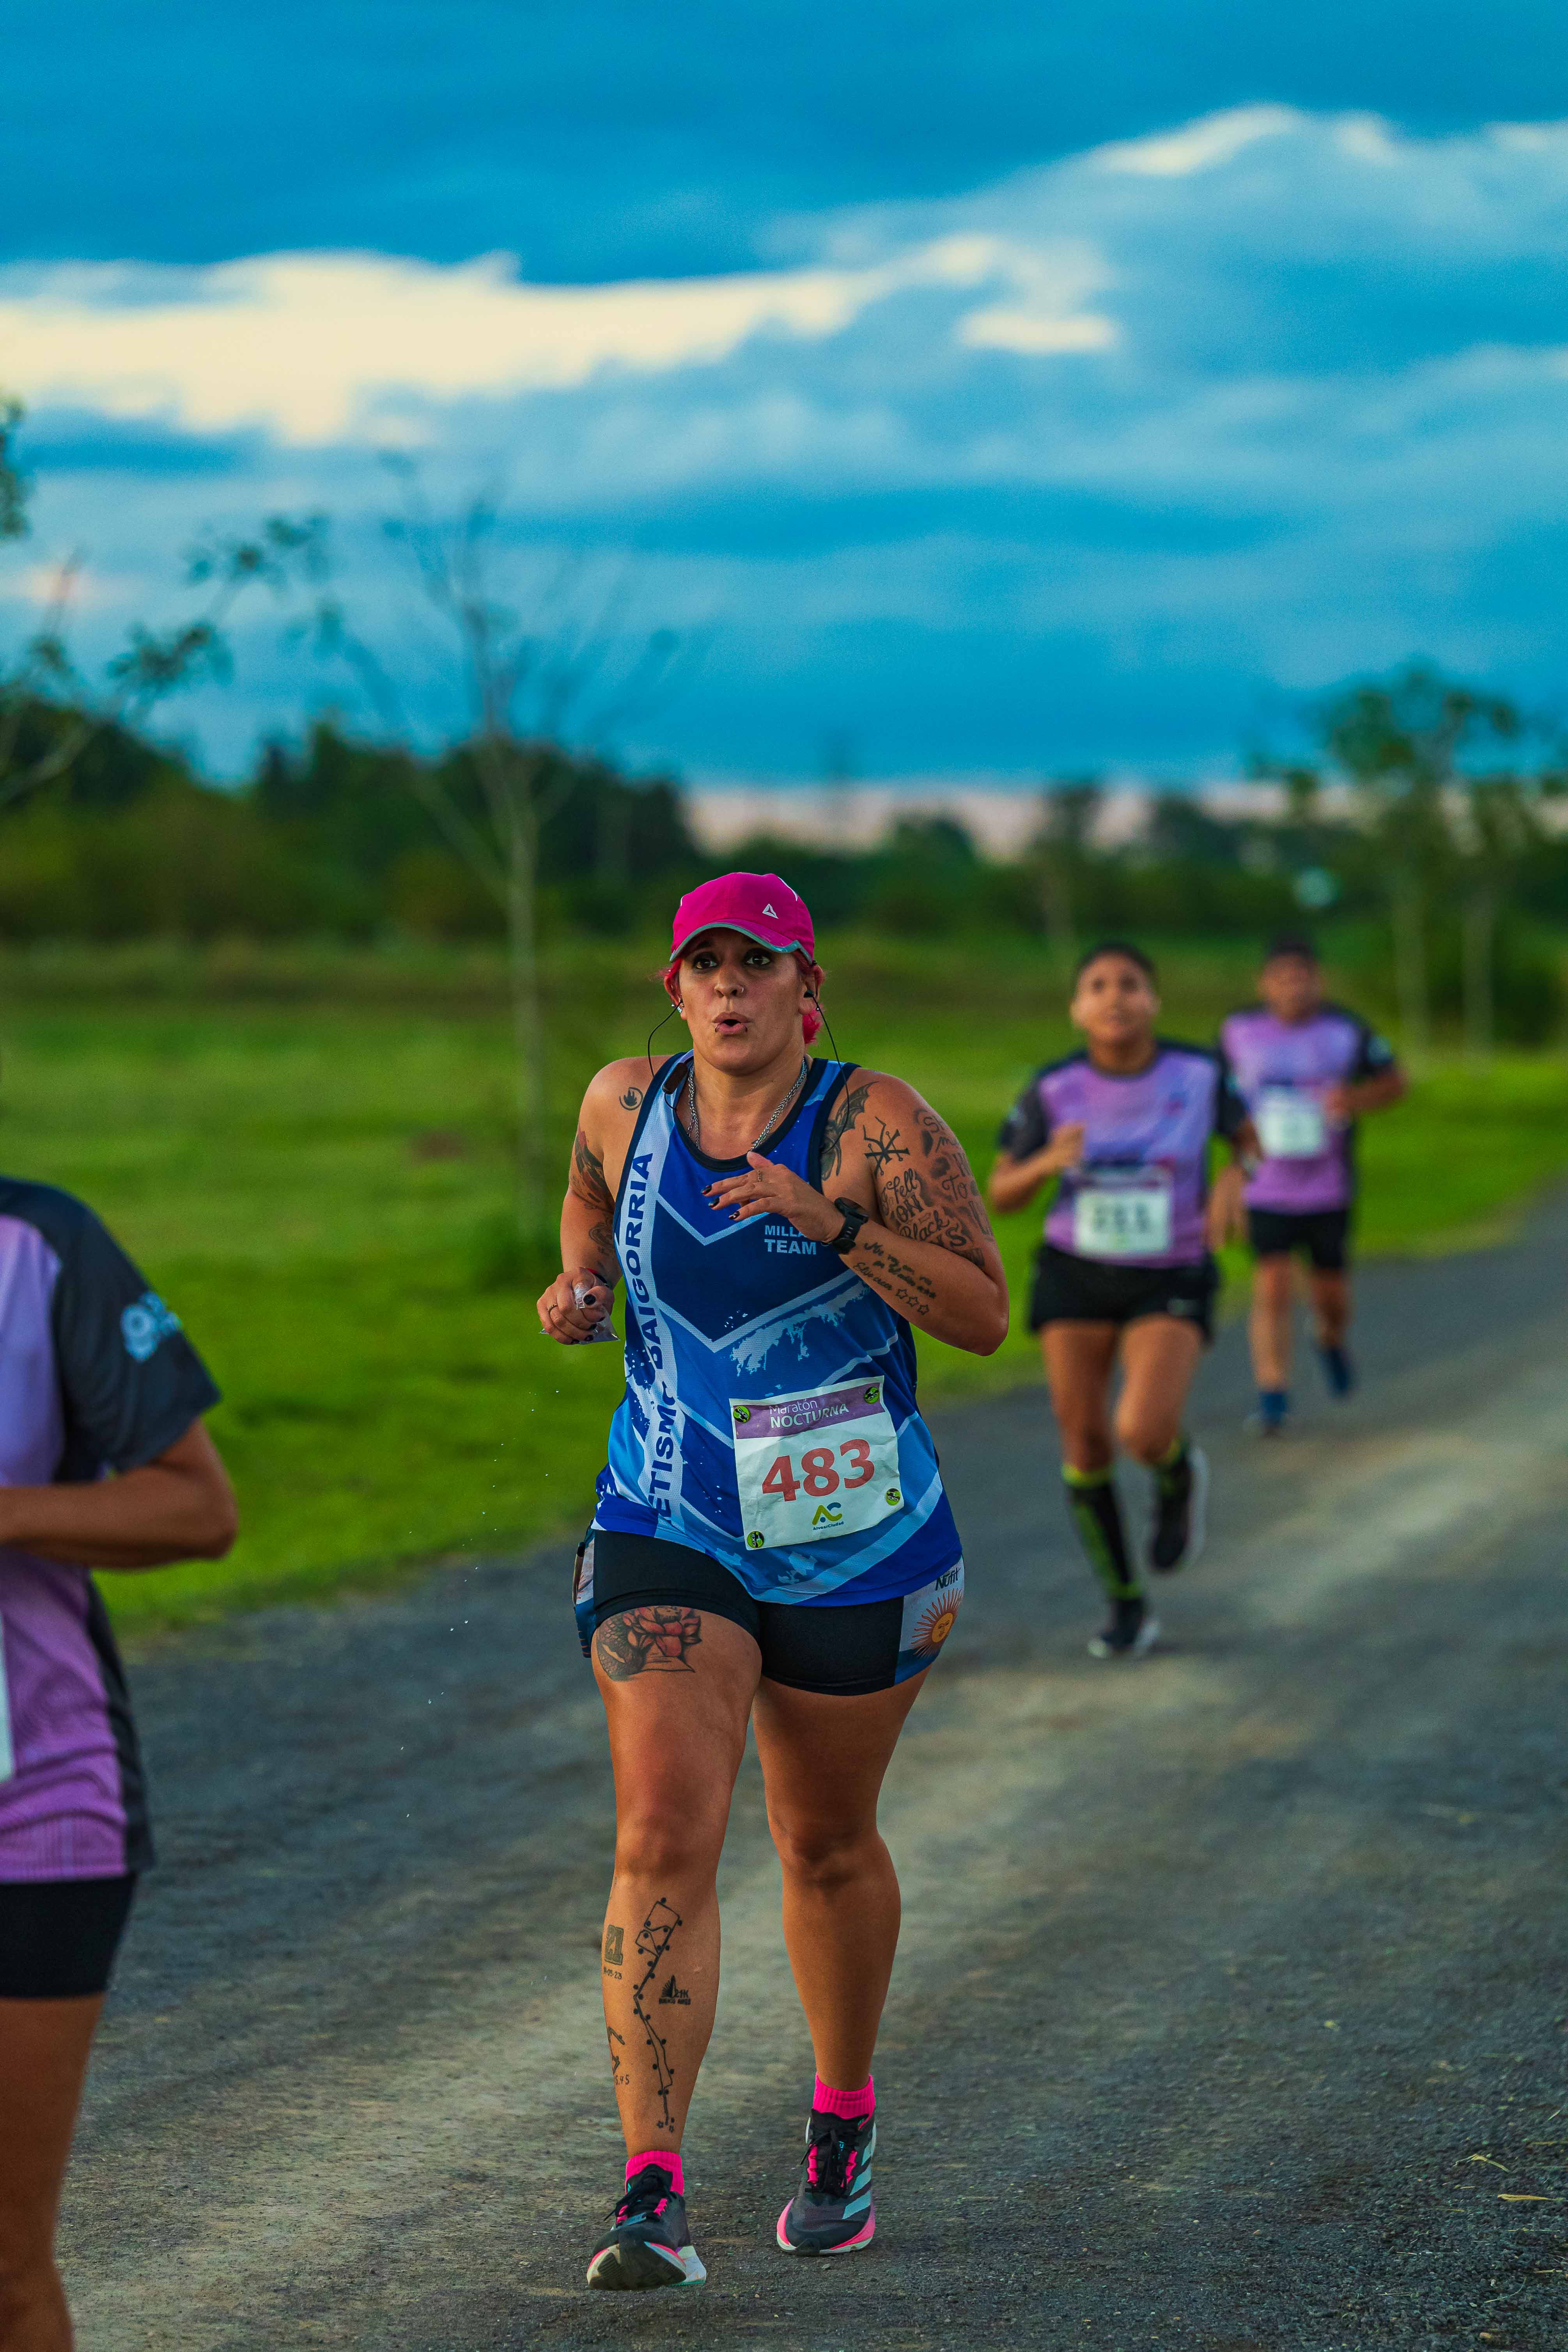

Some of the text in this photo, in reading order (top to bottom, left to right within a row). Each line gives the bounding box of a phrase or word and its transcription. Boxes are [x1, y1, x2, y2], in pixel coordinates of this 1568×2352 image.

[764, 1239, 817, 1255] TEAM
[625, 1153, 663, 1369] BAIGORRIA
[769, 1399, 818, 1415] Maratón
[770, 1403, 849, 1429] NOCTURNA
[762, 1438, 875, 1502] 483
[813, 1521, 844, 1530] AlvearCiudad
[604, 1924, 624, 1966] 21
